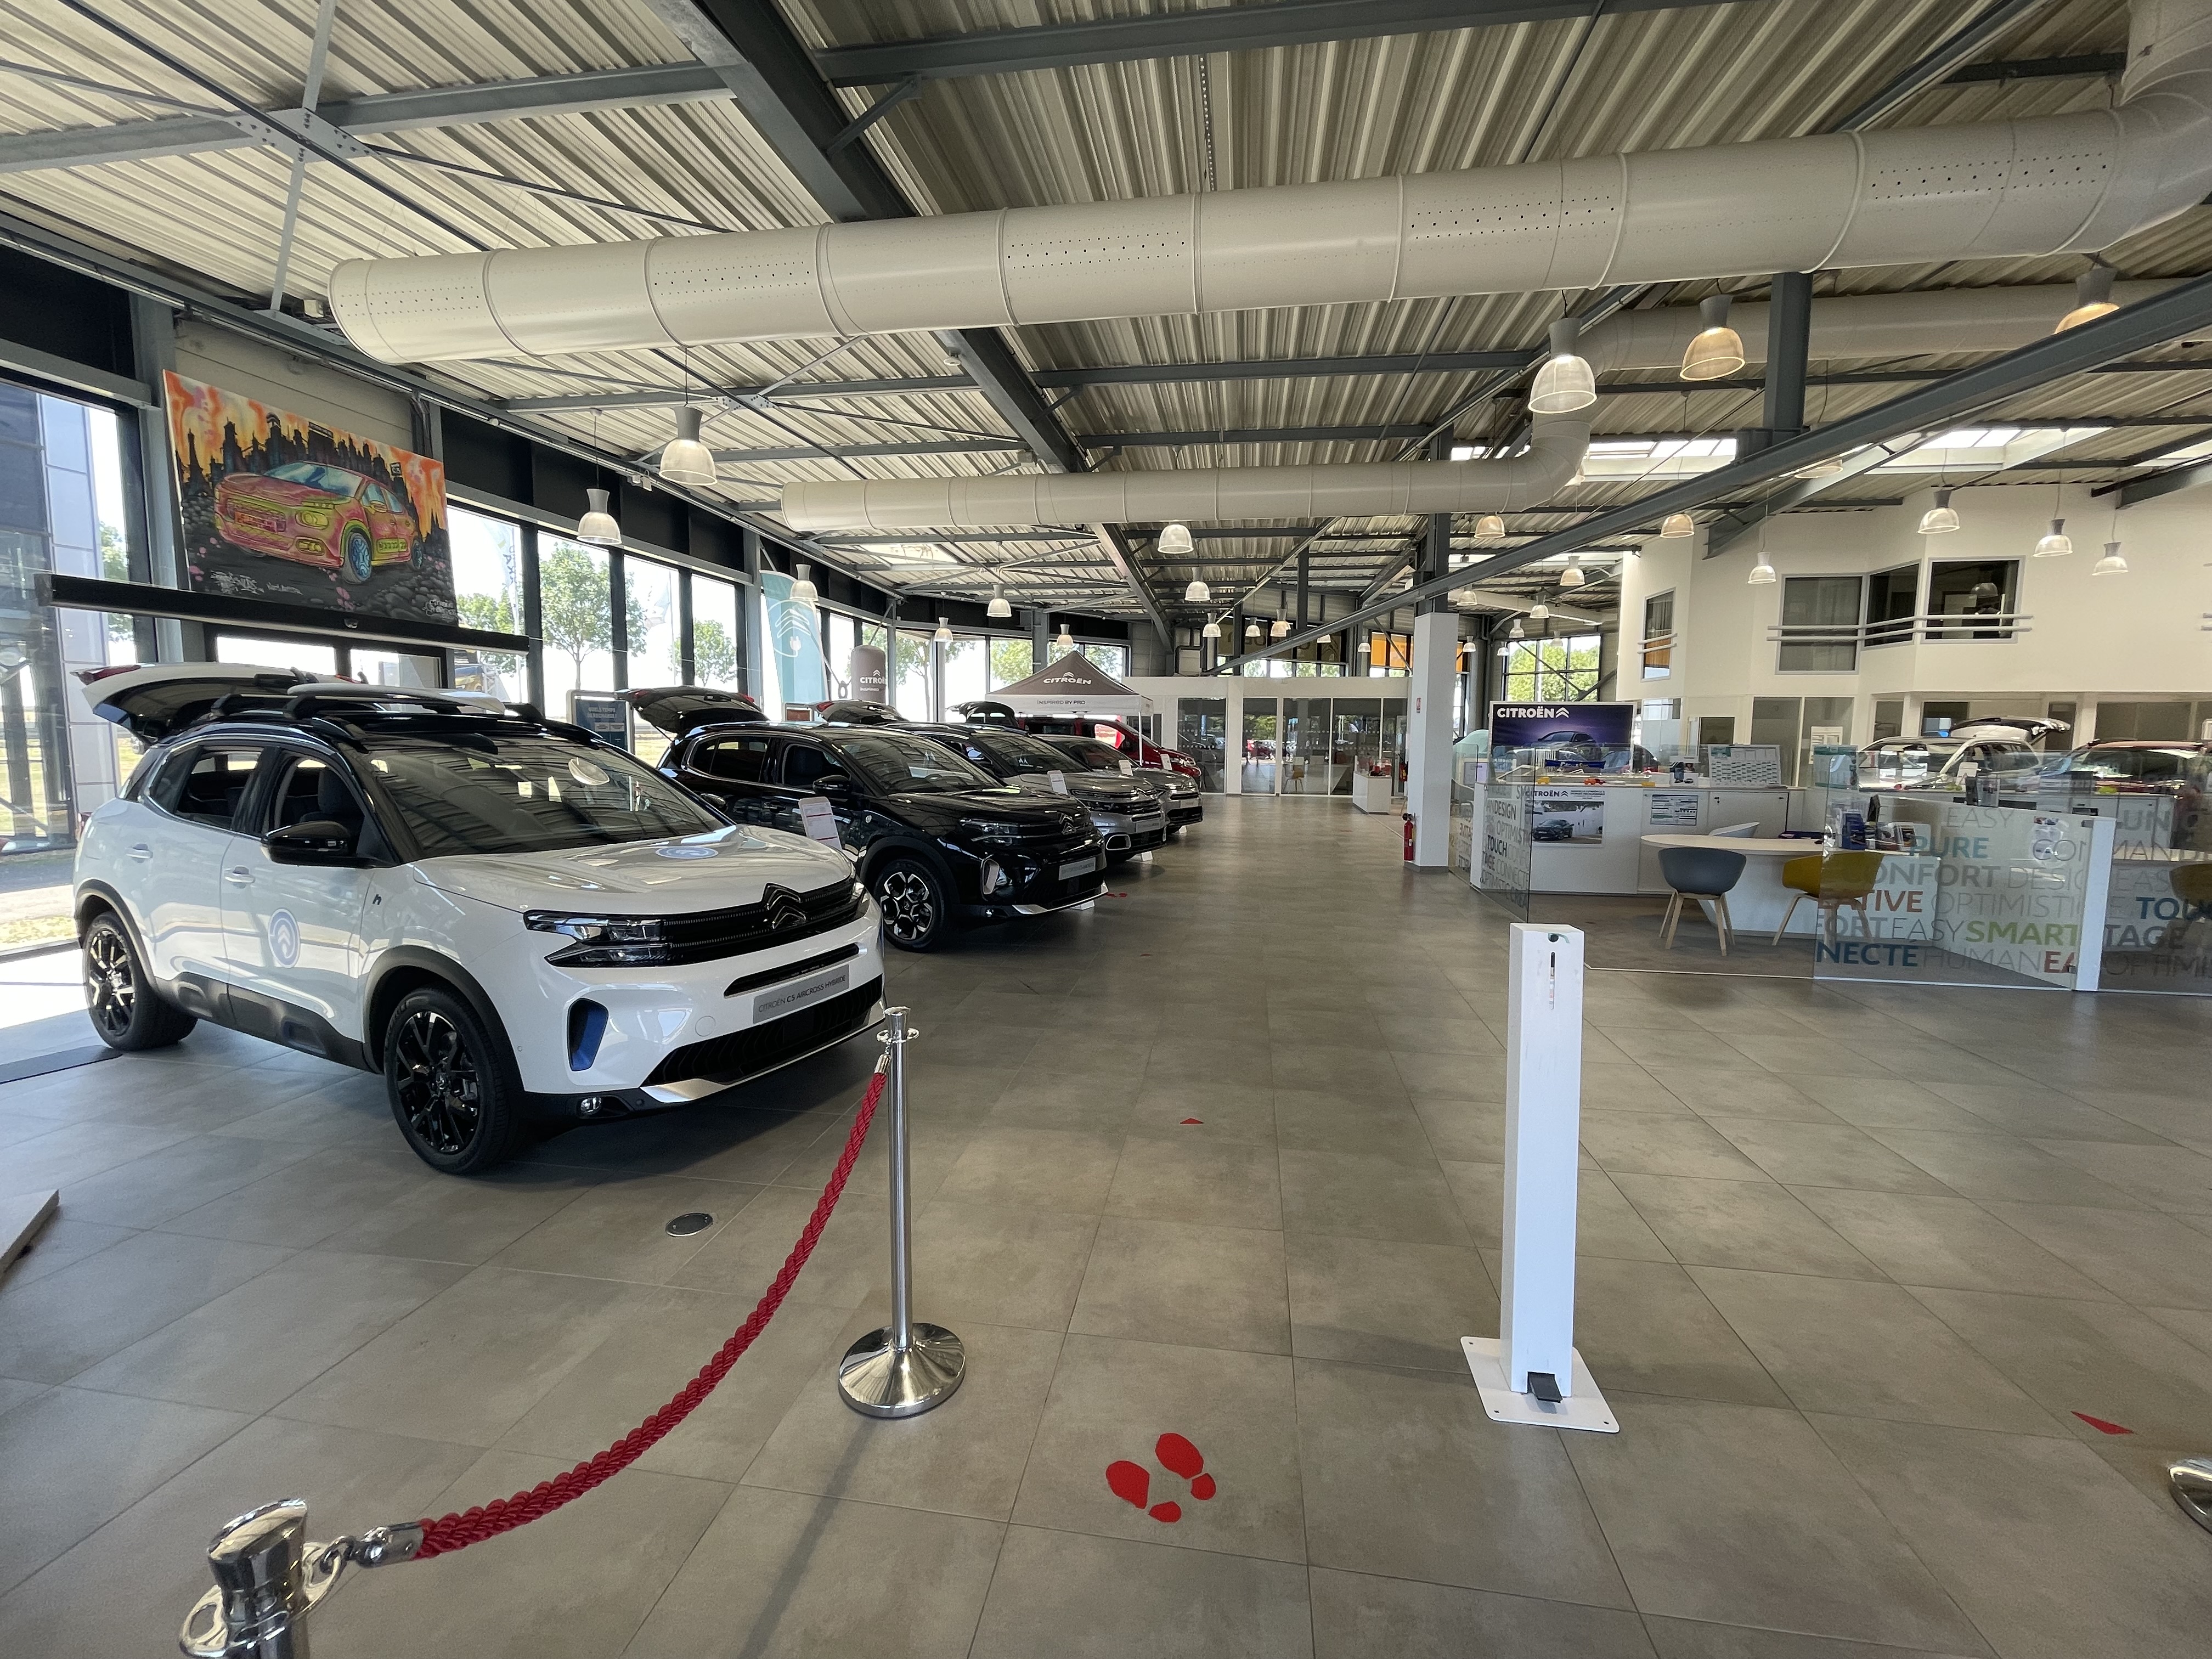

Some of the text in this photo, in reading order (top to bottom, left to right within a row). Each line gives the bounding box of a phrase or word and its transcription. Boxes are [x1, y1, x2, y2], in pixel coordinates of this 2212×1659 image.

[1497, 706, 1555, 718] CITROËN
[1494, 800, 1517, 821] DESIGN
[1947, 807, 2015, 829] EASY
[1487, 834, 1508, 858] TOUCH
[1910, 835, 1989, 859] PURE
[1892, 918, 1964, 942] EASY
[1966, 921, 2078, 946] SMART
[1922, 946, 2041, 977] HUMAN
[787, 994, 795, 1003] C5
[796, 985, 824, 1000] AIRCROSS
[825, 975, 846, 989] HYBRIDE
